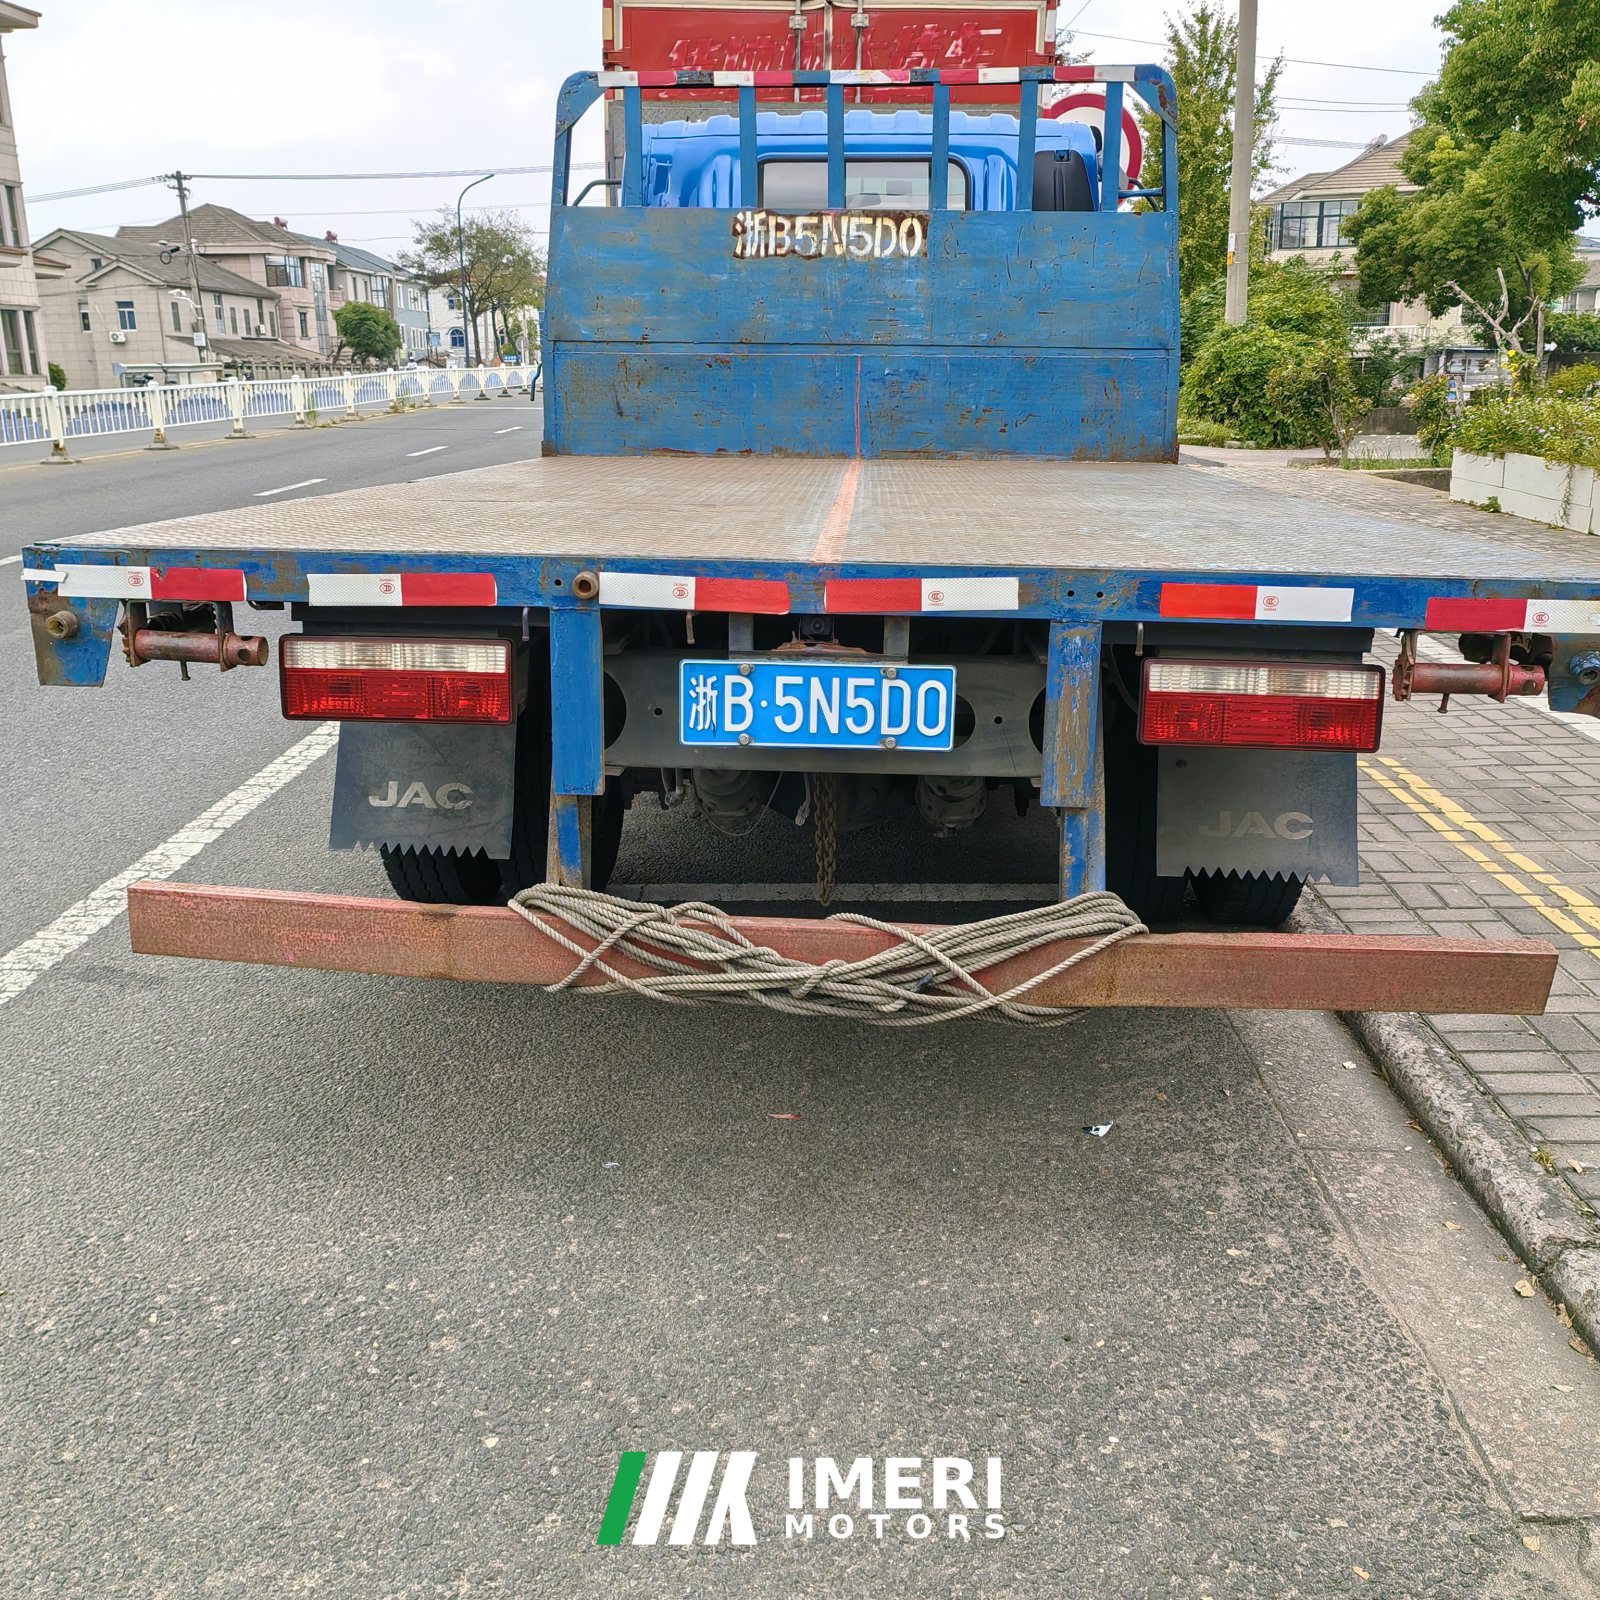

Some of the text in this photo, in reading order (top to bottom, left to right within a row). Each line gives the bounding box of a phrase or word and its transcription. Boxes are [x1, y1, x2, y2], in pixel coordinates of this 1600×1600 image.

[734, 211, 923, 258] 浙B5N5D0
[689, 674, 947, 737] 浙B·5N5D0
[368, 781, 475, 810] JAC
[1198, 810, 1314, 840] JAC
